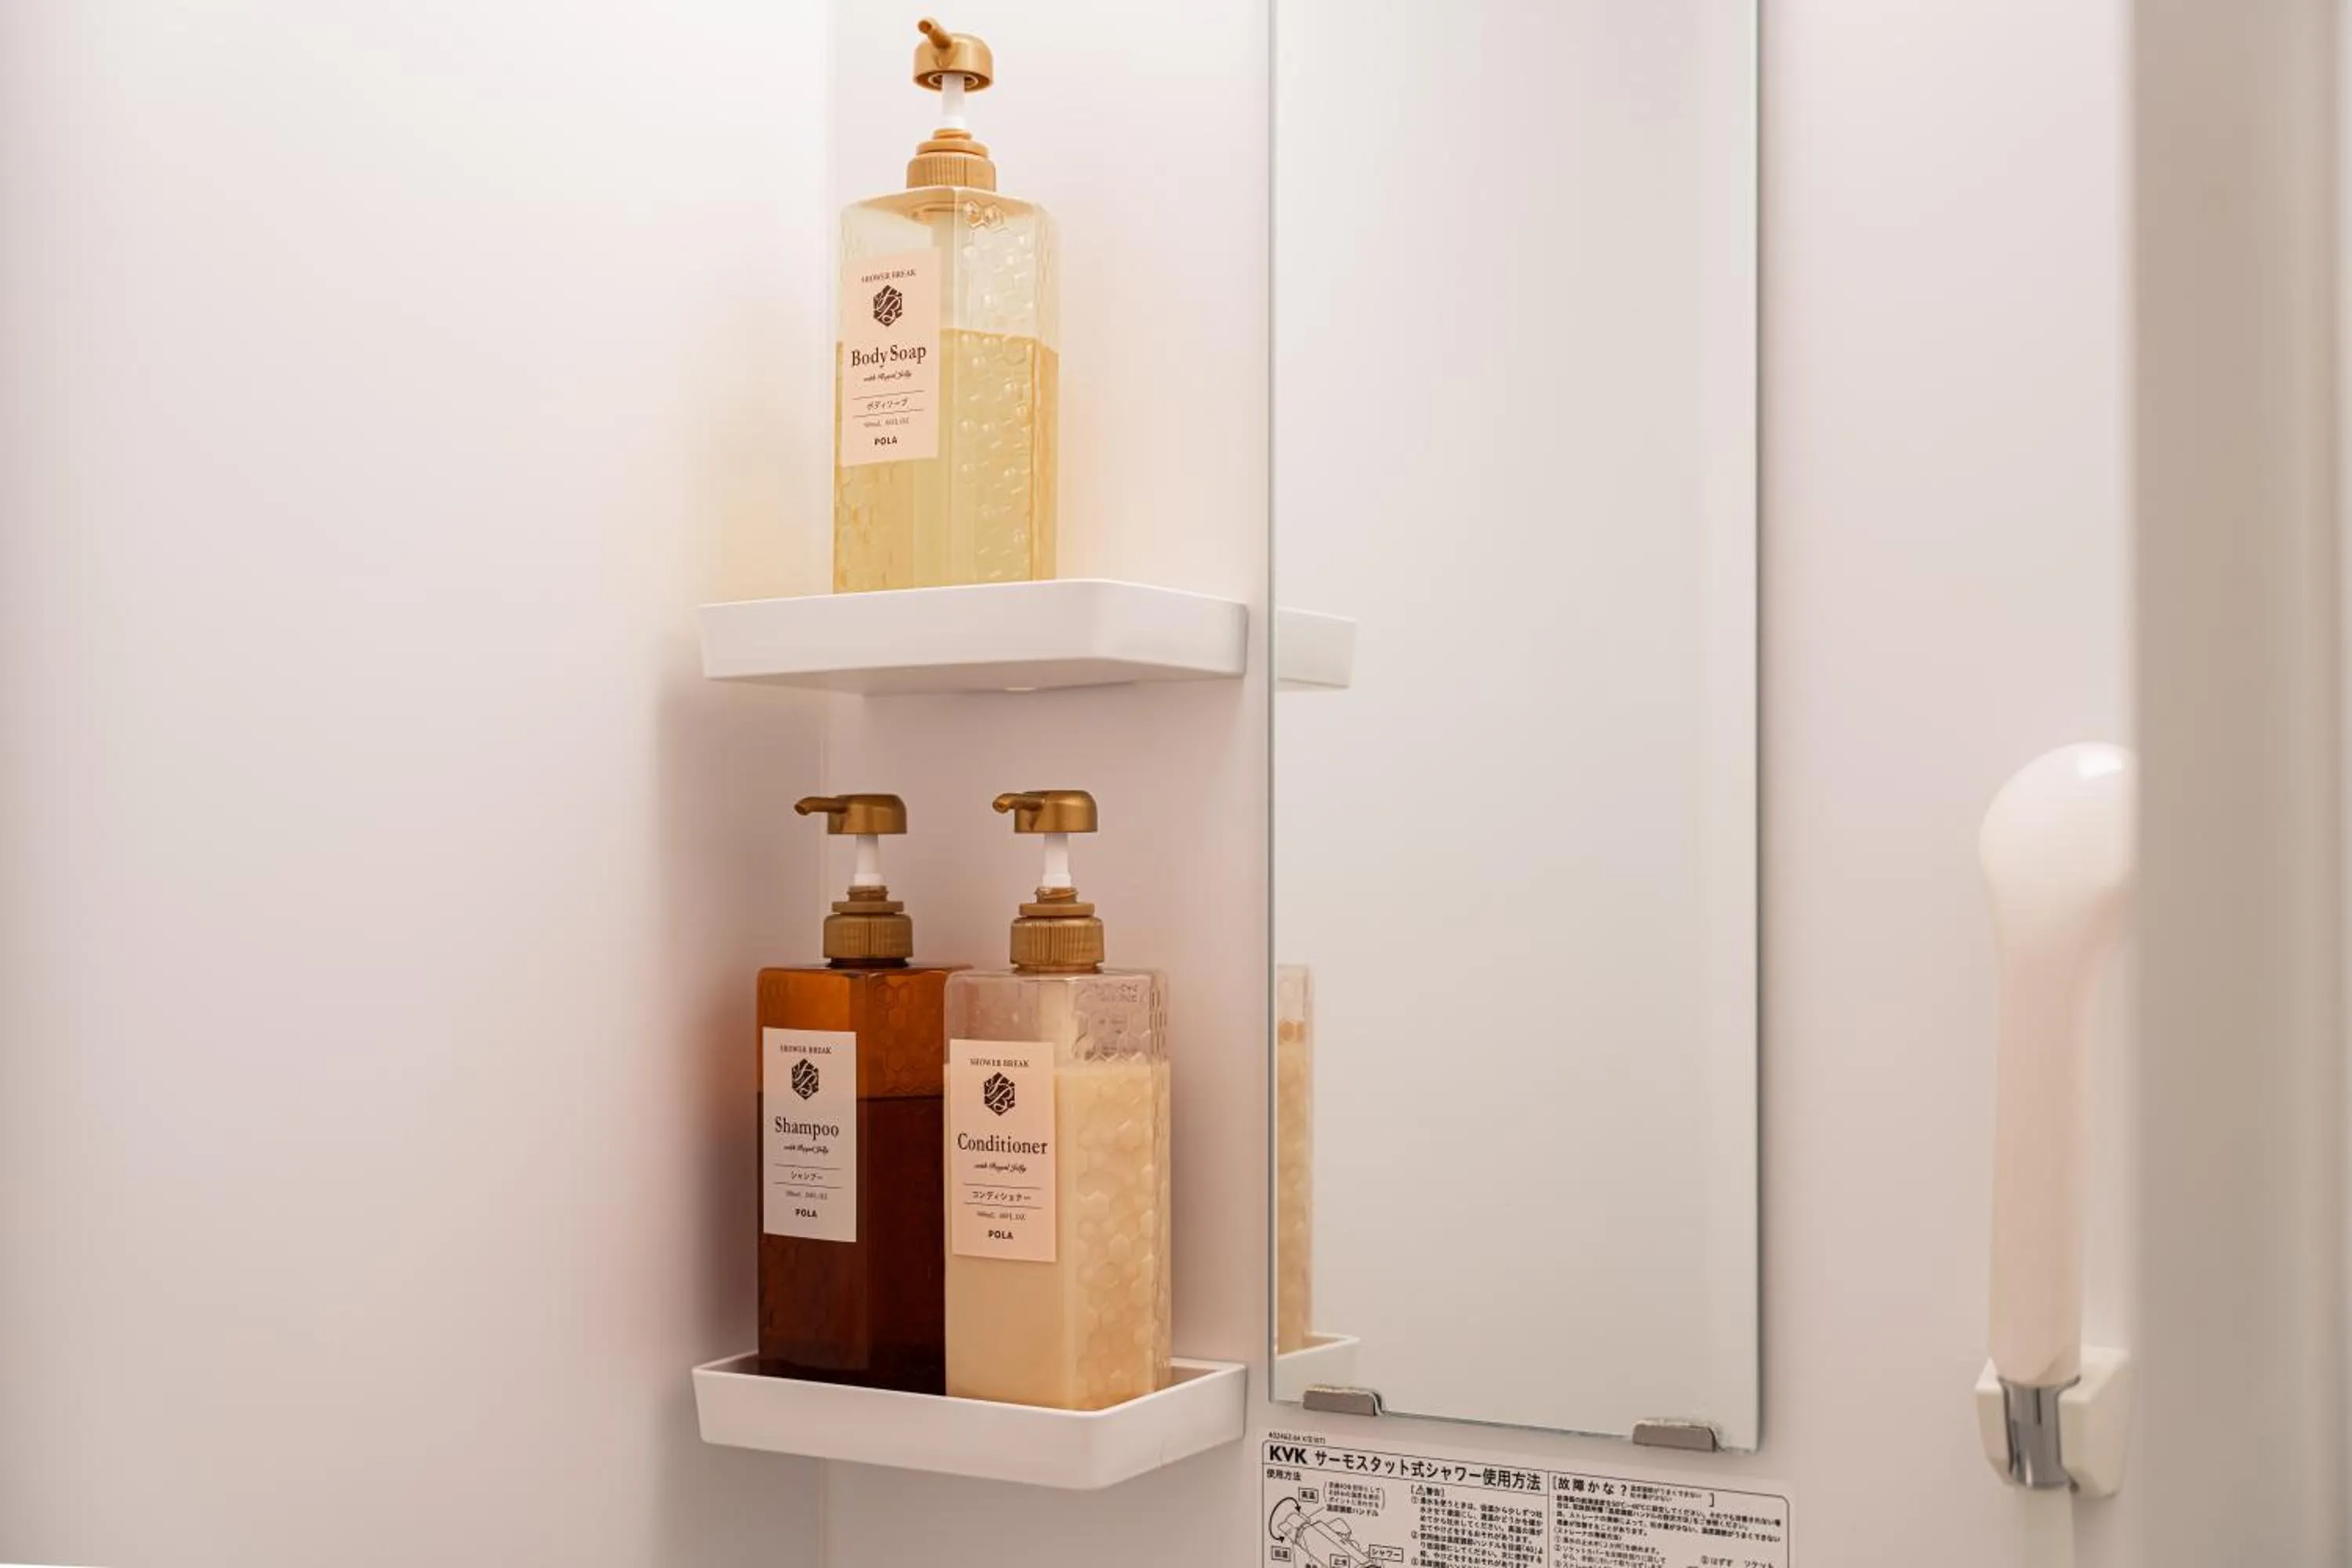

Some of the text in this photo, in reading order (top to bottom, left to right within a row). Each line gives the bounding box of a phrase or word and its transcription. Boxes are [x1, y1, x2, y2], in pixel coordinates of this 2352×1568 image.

[851, 344, 927, 368] Body Soap
[874, 436, 898, 446] POLA
[774, 1116, 840, 1140] Shampoo
[957, 1133, 1048, 1155] Conditioner
[972, 1191, 1031, 1202] コンディショナー
[795, 1208, 818, 1218] POLA
[988, 1229, 1014, 1240] POLA
[1269, 1445, 1541, 1491] KVK サーモスタット式シャワー使用方法
[1266, 1468, 1301, 1482] 使用方法
[1371, 1548, 1400, 1559] シャワー
